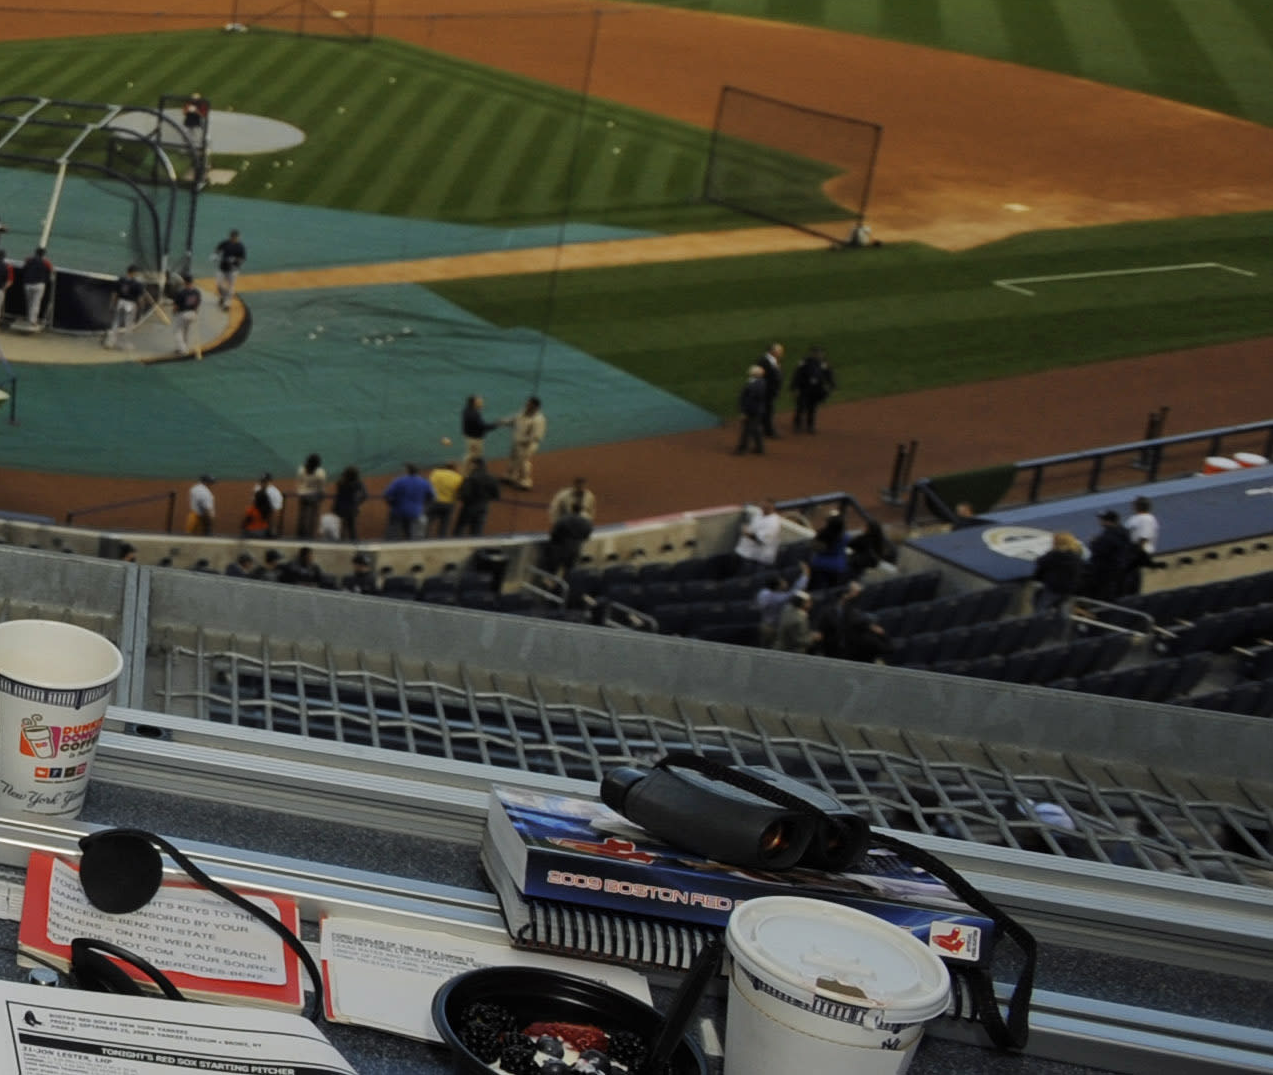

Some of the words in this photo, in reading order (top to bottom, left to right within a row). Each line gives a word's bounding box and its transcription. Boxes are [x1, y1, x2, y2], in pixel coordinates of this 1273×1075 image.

[0, 779, 27, 800] New
[27, 790, 59, 808] York
[547, 870, 603, 891] 2009
[603, 879, 690, 904] BOSTON
[690, 891, 732, 911] RED
[50, 897, 150, 930] MERCEDES-BENZ
[155, 925, 216, 940] TRI-STATE
[178, 904, 210, 916] KEYS
[214, 909, 230, 918] TO
[50, 907, 102, 931] DEALERS
[115, 928, 132, 938] ON
[136, 932, 160, 943] THE
[164, 938, 192, 948] WEB
[195, 942, 210, 950] AT
[214, 945, 267, 961] SEARCH
[193, 920, 212, 929] BY
[213, 923, 250, 934] YOUR
[50, 918, 113, 943] MERCEDES
[116, 938, 140, 948] DOT
[144, 944, 173, 956] COM
[184, 953, 220, 964] YOUR
[223, 959, 278, 973] SOURCE
[154, 958, 264, 980] MERCEDES-BENZ
[101, 1047, 154, 1062] TONIGHT'S
[155, 1054, 176, 1065] RED
[177, 1057, 198, 1067] SOX
[199, 1060, 249, 1073] STARTING
[250, 1065, 295, 1075] PITCHER
